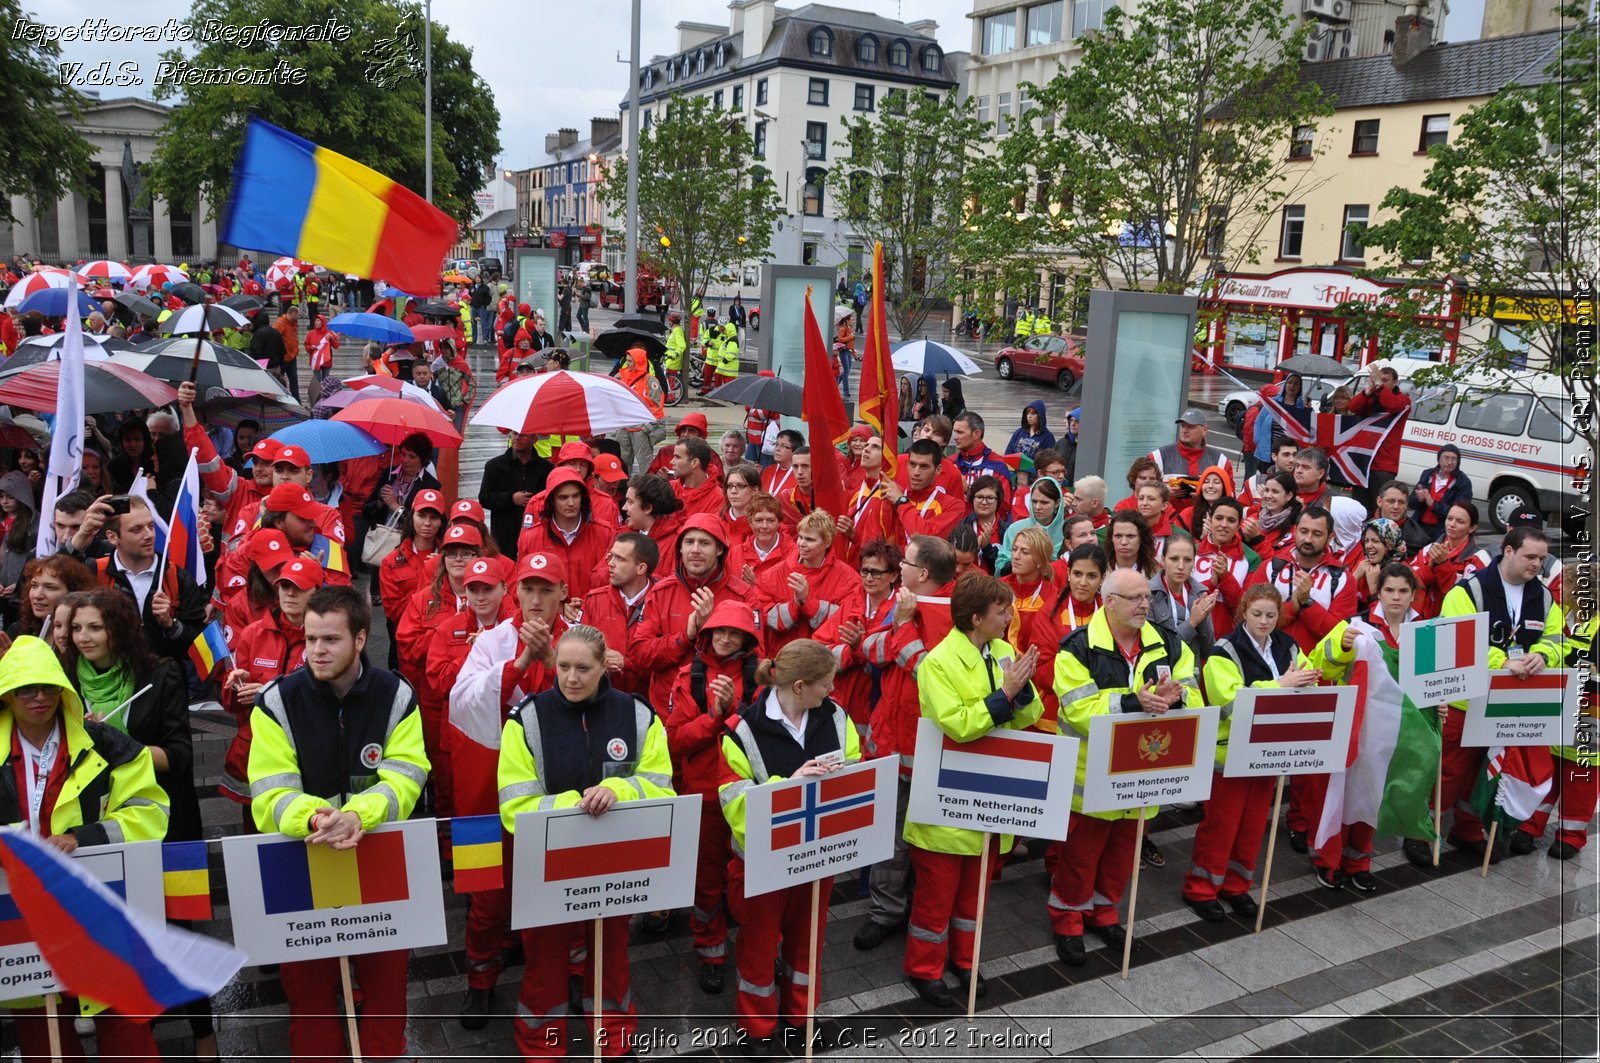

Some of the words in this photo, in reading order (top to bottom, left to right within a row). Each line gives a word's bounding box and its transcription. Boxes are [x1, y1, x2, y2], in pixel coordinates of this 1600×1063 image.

[1261, 285, 1292, 299] Travel
[1325, 285, 1379, 305] Falcon
[1410, 426, 1435, 439] IRISH
[1437, 430, 1457, 442] RED
[1460, 434, 1495, 449] CROSS
[1496, 439, 1543, 456] SOCIETY
[1424, 679, 1443, 687] Team
[1444, 674, 1460, 684] Italy
[1461, 673, 1466, 681] 1
[1423, 690, 1442, 699] Team
[1443, 686, 1461, 696] Italia
[1462, 684, 1467, 692] 1
[1518, 721, 1547, 730] Hungry
[1516, 731, 1543, 739] Csapat
[1262, 749, 1286, 757] Team
[1288, 747, 1316, 756] Latvia
[1248, 760, 1291, 770] Komanda
[1294, 759, 1324, 769] Latvija
[1111, 781, 1135, 789] Team
[1138, 775, 1190, 787] Montenegro
[1116, 792, 1134, 801] Тим
[1136, 790, 1159, 799] Црна
[1161, 787, 1182, 796] Гора
[938, 793, 969, 806] Team
[972, 798, 1044, 815] Netherlands
[941, 808, 973, 820] Team
[976, 813, 1037, 828] Nederland
[787, 849, 816, 862] Team
[819, 838, 858, 854] Norway
[786, 859, 825, 876] Teamet
[828, 851, 859, 866] Norge
[564, 885, 601, 897] Team
[605, 877, 650, 892] Poland
[564, 900, 601, 912] Team
[605, 894, 648, 907] Polska
[287, 920, 326, 932] Team
[330, 911, 392, 927] Romania
[285, 935, 332, 948] Echipa
[336, 927, 398, 942] România
[0, 970, 53, 986] орная
